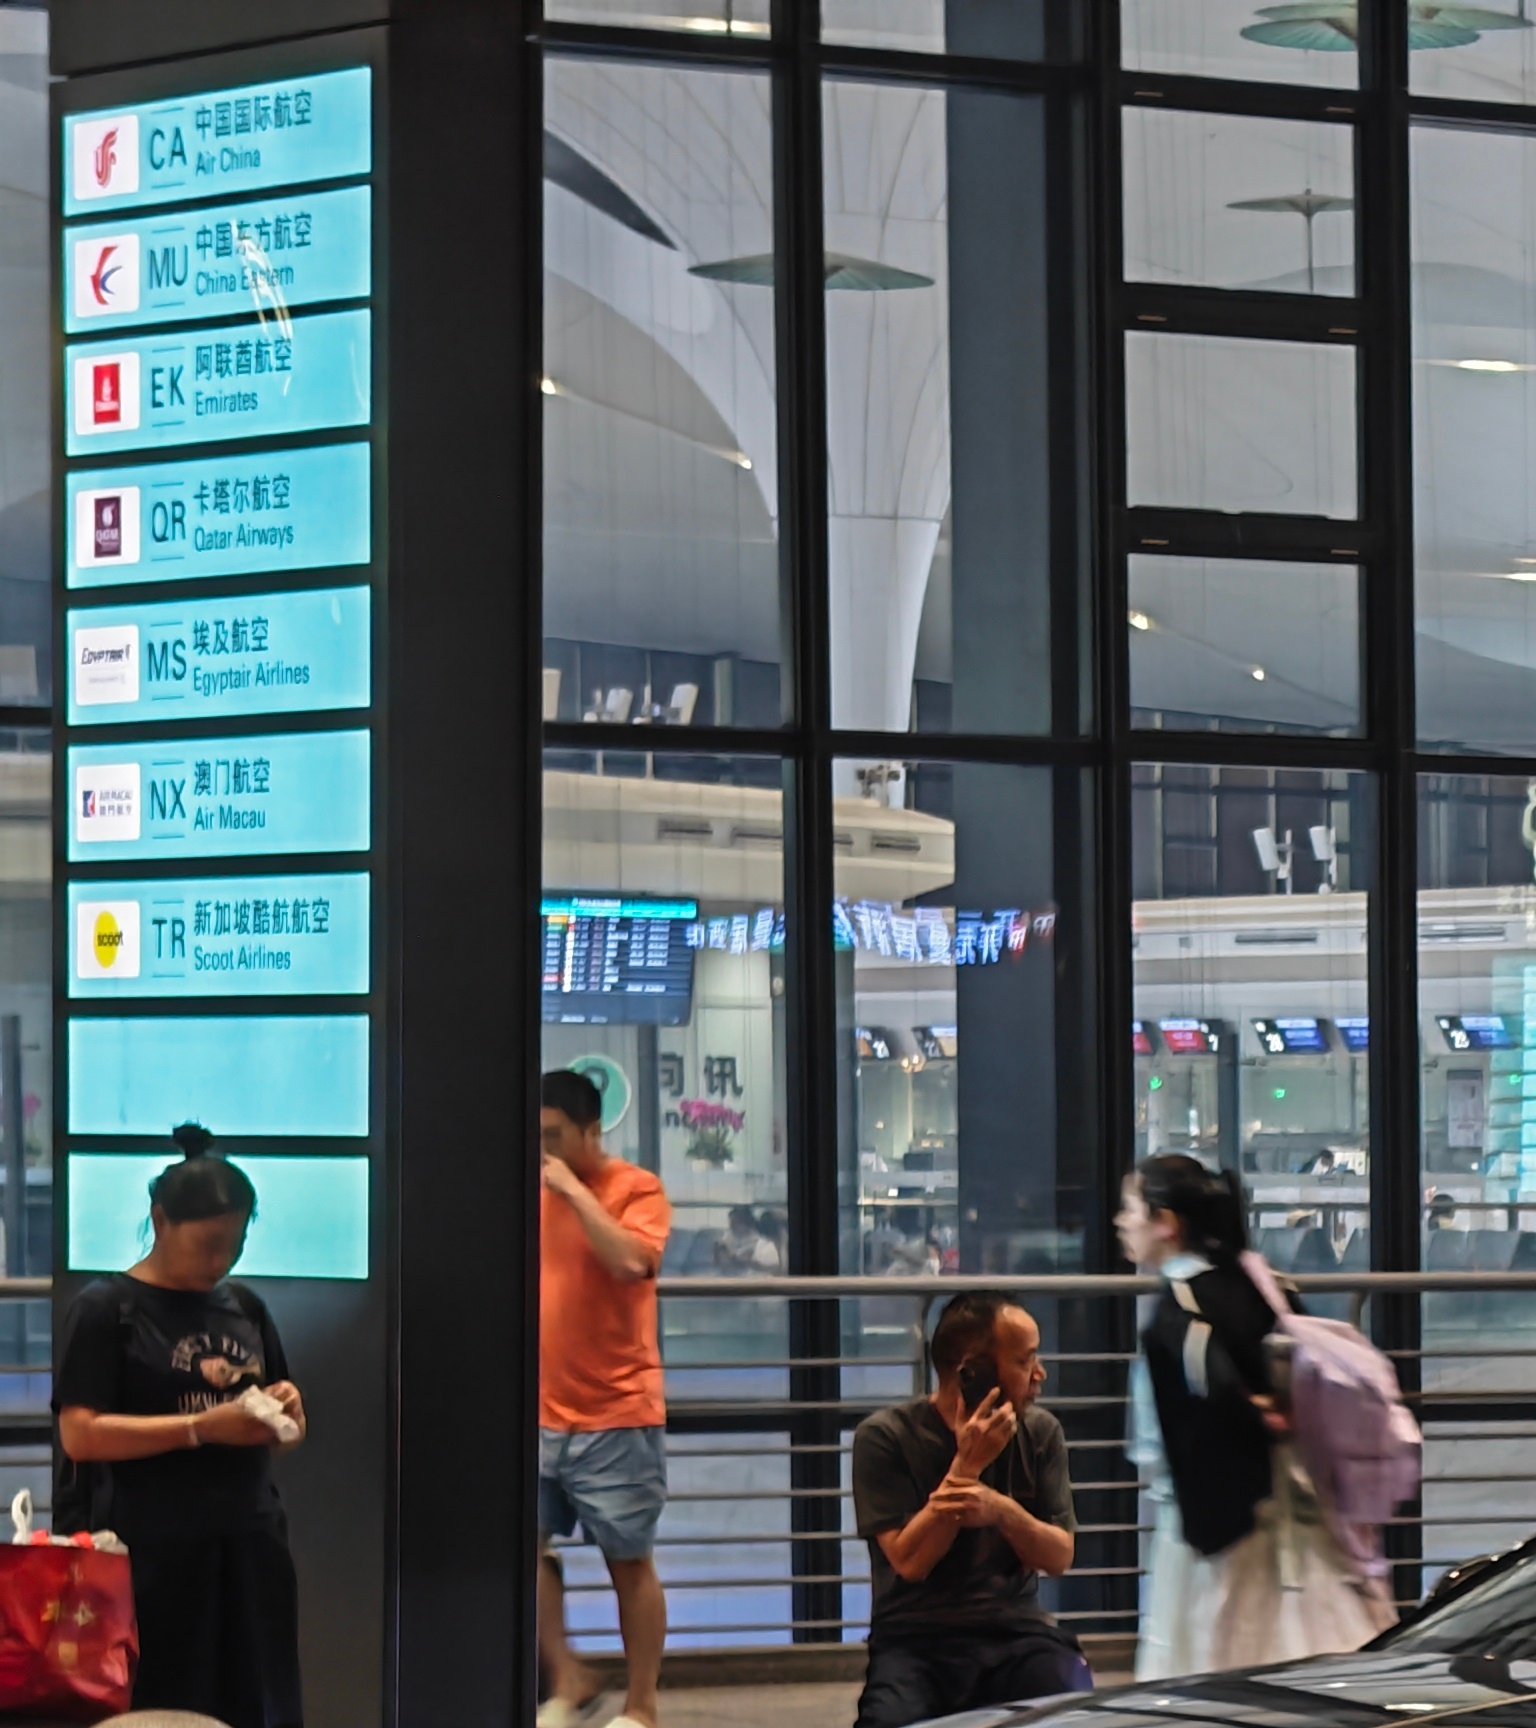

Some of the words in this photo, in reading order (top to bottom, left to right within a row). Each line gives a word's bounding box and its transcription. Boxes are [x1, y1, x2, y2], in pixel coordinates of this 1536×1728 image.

[195, 89, 313, 141] 中国国际航空
[149, 126, 188, 171] CA
[195, 153, 215, 176] Air
[219, 147, 261, 172] China
[195, 212, 313, 262] 中国东方航空
[148, 244, 190, 290] MU
[195, 268, 237, 297] China
[241, 263, 295, 290] Eastern
[195, 337, 293, 382] 阿联酋航空
[150, 366, 186, 409] EK
[195, 390, 259, 417] Emirates
[193, 473, 291, 517] 卡塔尔航空
[150, 501, 187, 543] QR
[194, 526, 232, 553] Qatar
[235, 521, 295, 551] Airways
[193, 615, 269, 657] 埃及航空
[147, 639, 188, 682] MS
[193, 666, 252, 697] Egyptair
[255, 661, 310, 688] Airlines
[194, 757, 271, 797] 澳门航空
[150, 777, 187, 821] NX
[194, 807, 215, 831] Air
[218, 805, 267, 830] Macau
[194, 896, 330, 937] 新加坡酷航航空
[151, 917, 187, 959] TR
[194, 945, 235, 971] Scoot
[238, 942, 292, 970] Airlines
